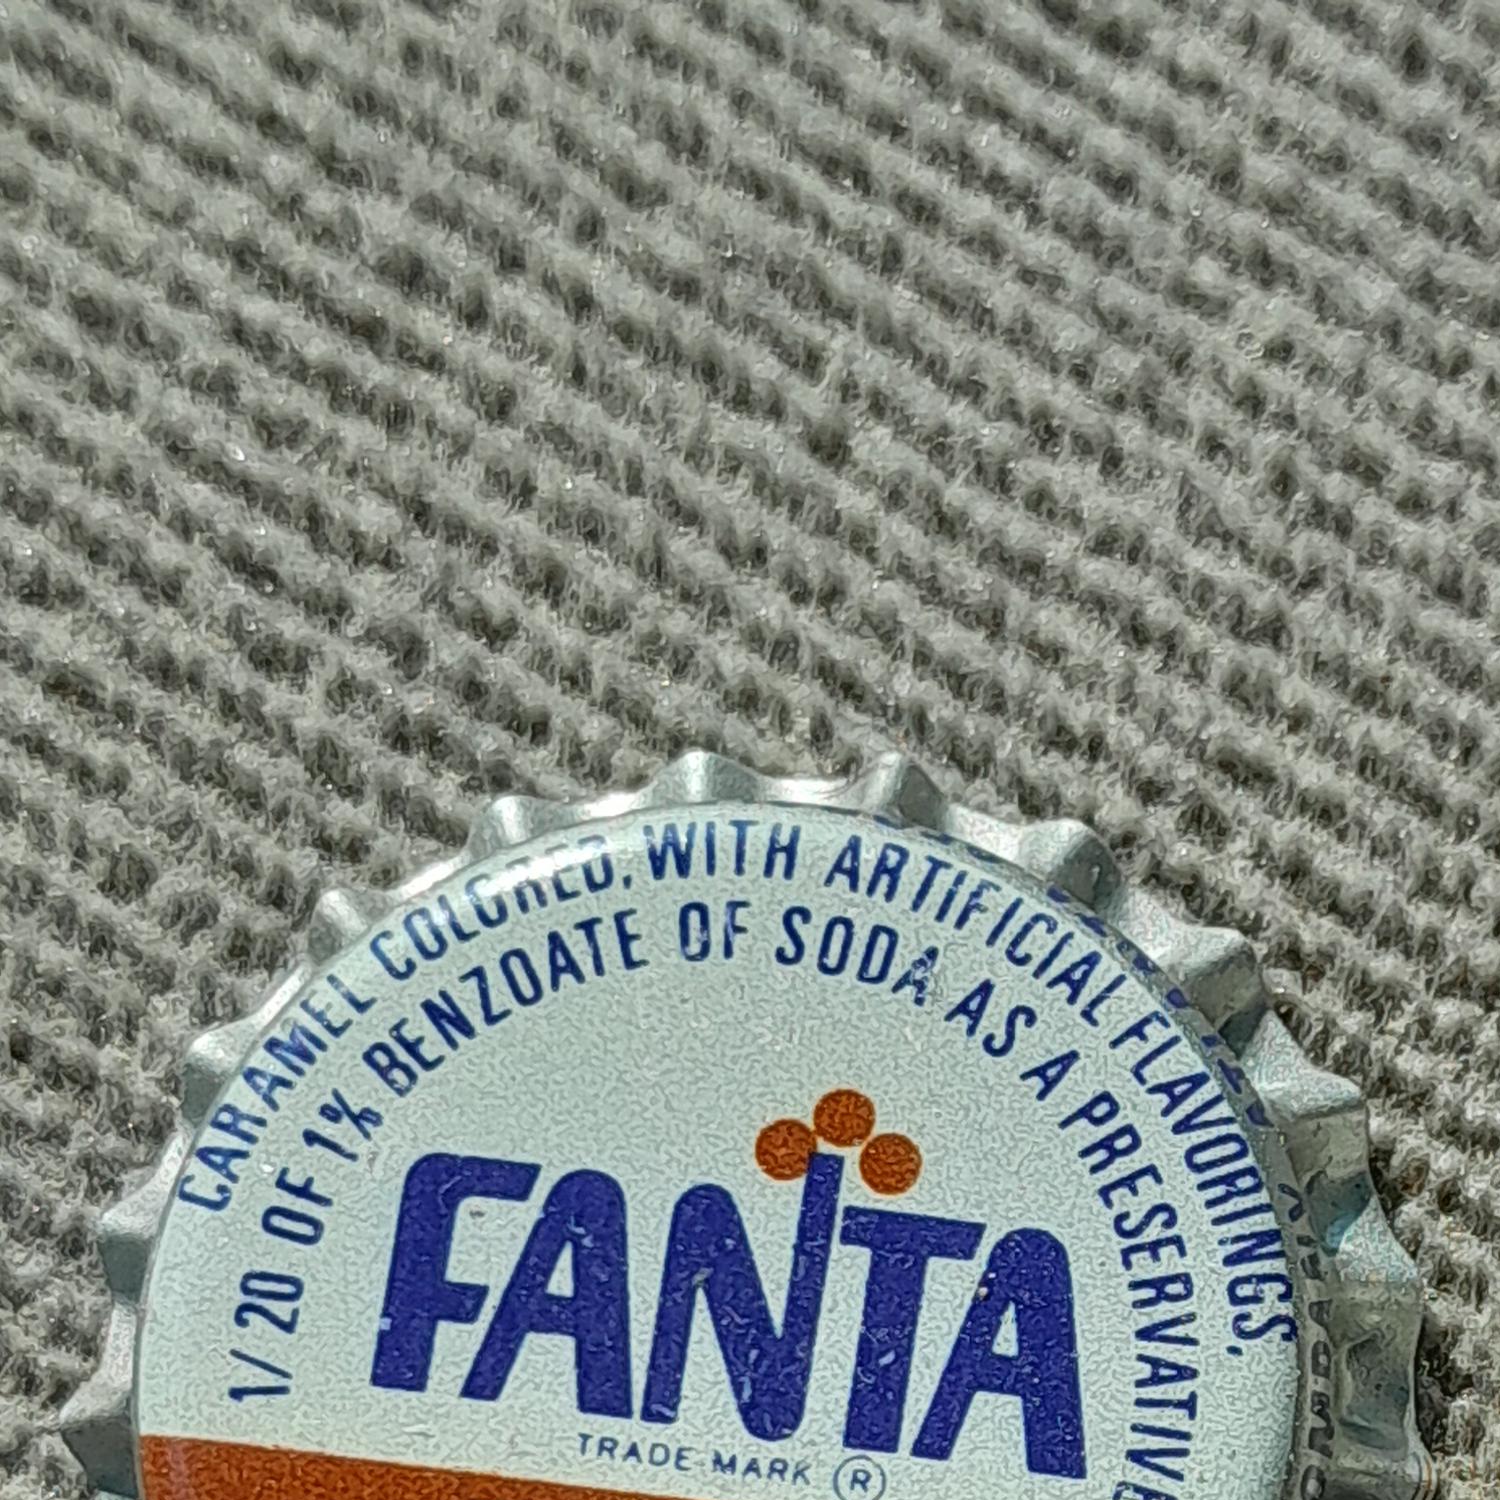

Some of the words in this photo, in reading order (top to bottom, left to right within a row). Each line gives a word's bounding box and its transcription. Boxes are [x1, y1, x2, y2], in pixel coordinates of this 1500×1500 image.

[177, 972, 377, 1212] CARAMEL
[643, 818, 801, 881] WITH
[823, 833, 1128, 1028] ARTIFICIAL
[1108, 1009, 1298, 1356] FLAVORINGS,
[261, 1166, 334, 1246] OF
[302, 1088, 384, 1162] 1%
[362, 908, 650, 1098] BENZOATE
[678, 901, 751, 962] OF
[776, 905, 941, 1006] SODA
[944, 979, 1038, 1058] AS
[1018, 1049, 1081, 1101] A
[369, 1151, 1089, 1481] FANTA
[577, 1432, 693, 1472] TRADE
[711, 1450, 812, 1487] MARK
